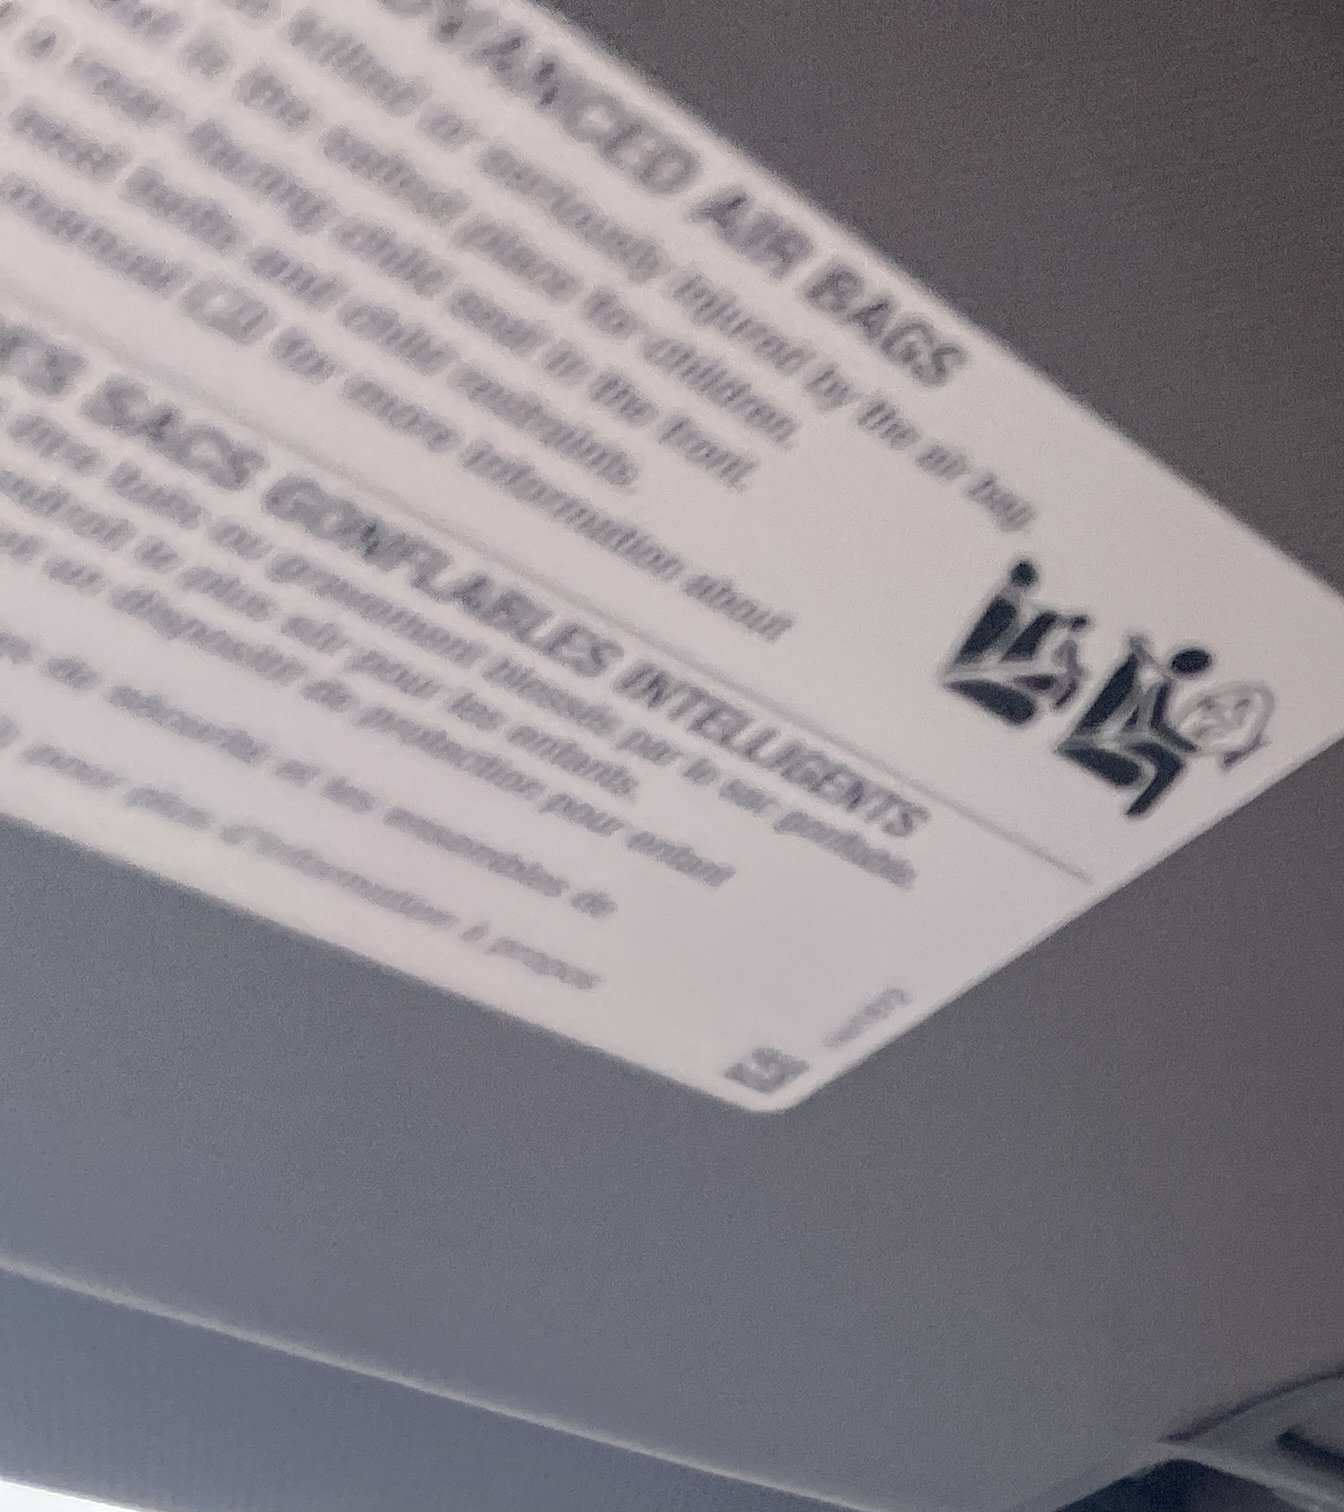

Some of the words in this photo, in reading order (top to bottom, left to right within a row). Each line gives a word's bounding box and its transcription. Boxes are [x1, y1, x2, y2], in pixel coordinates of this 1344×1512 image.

[385, 0, 700, 197] VANCED
[682, 185, 817, 283] AIR
[796, 258, 970, 390] BAGS
[259, 472, 625, 680] GONFLABLES
[611, 658, 932, 839] INTELLIGENTS
